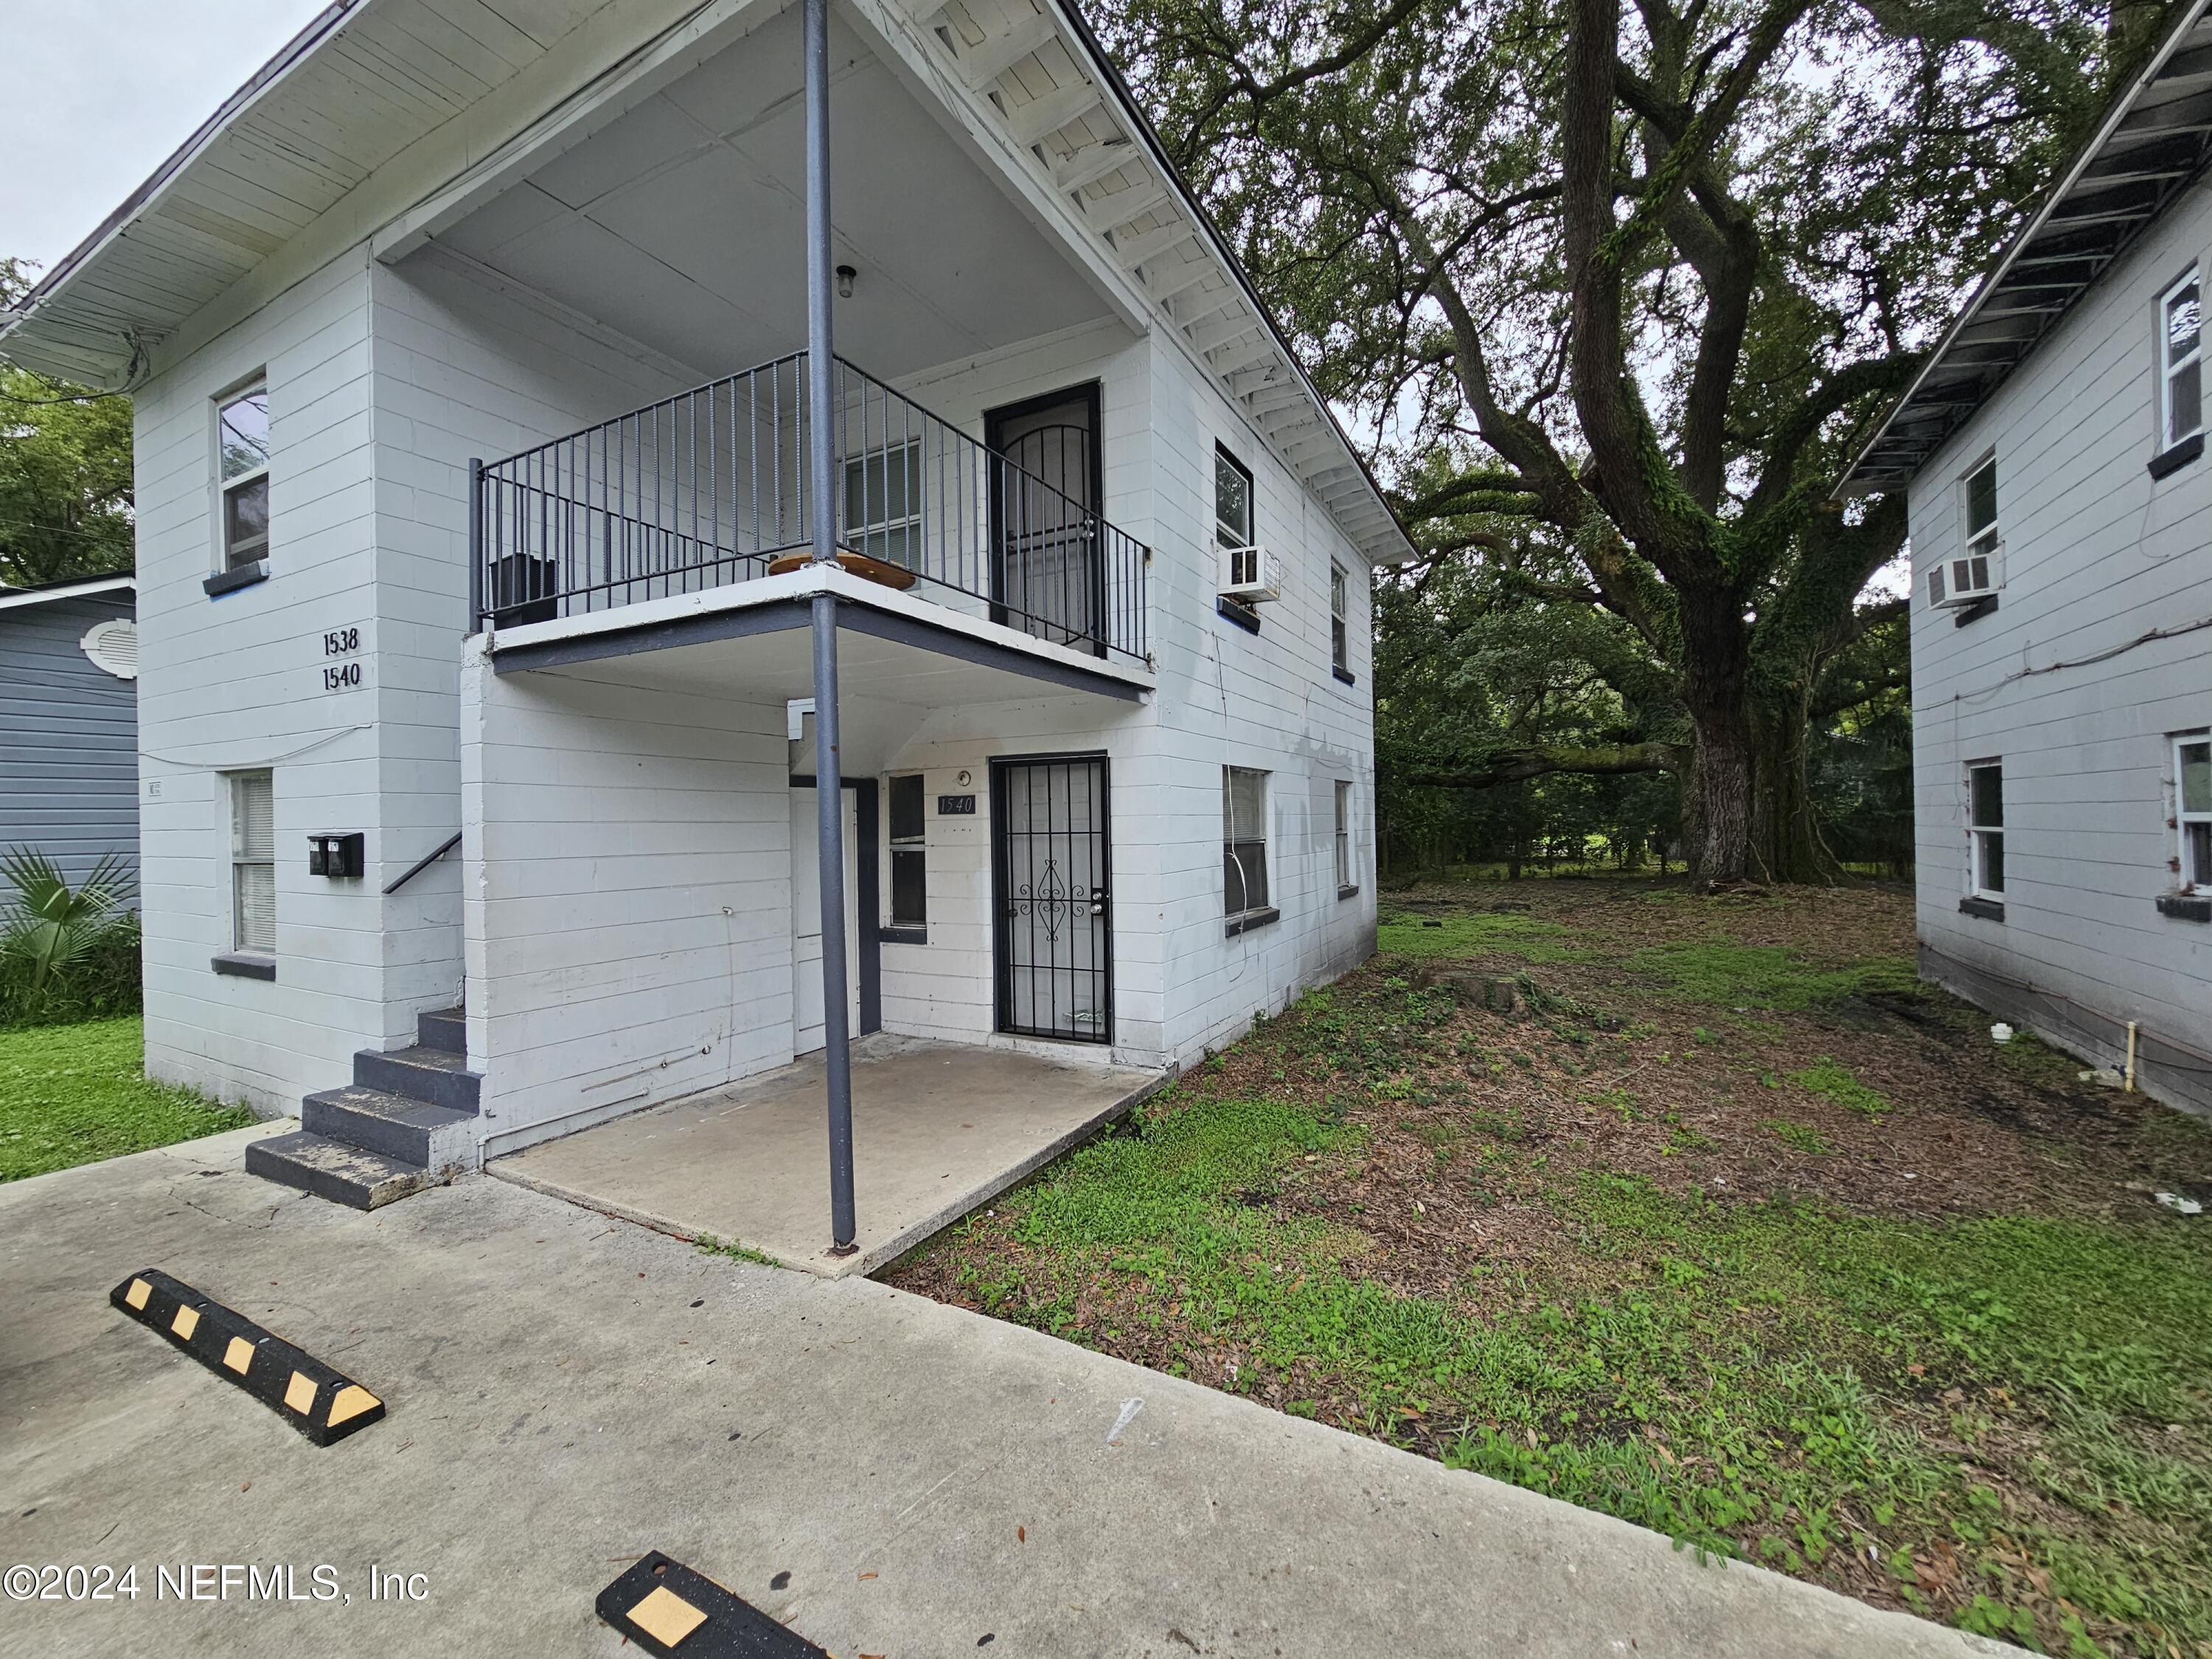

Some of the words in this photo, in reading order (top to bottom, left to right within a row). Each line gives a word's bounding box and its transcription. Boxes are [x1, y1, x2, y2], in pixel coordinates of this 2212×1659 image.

[324, 628, 358, 655] 1538
[323, 664, 360, 690] 1540
[942, 797, 972, 813] 1540
